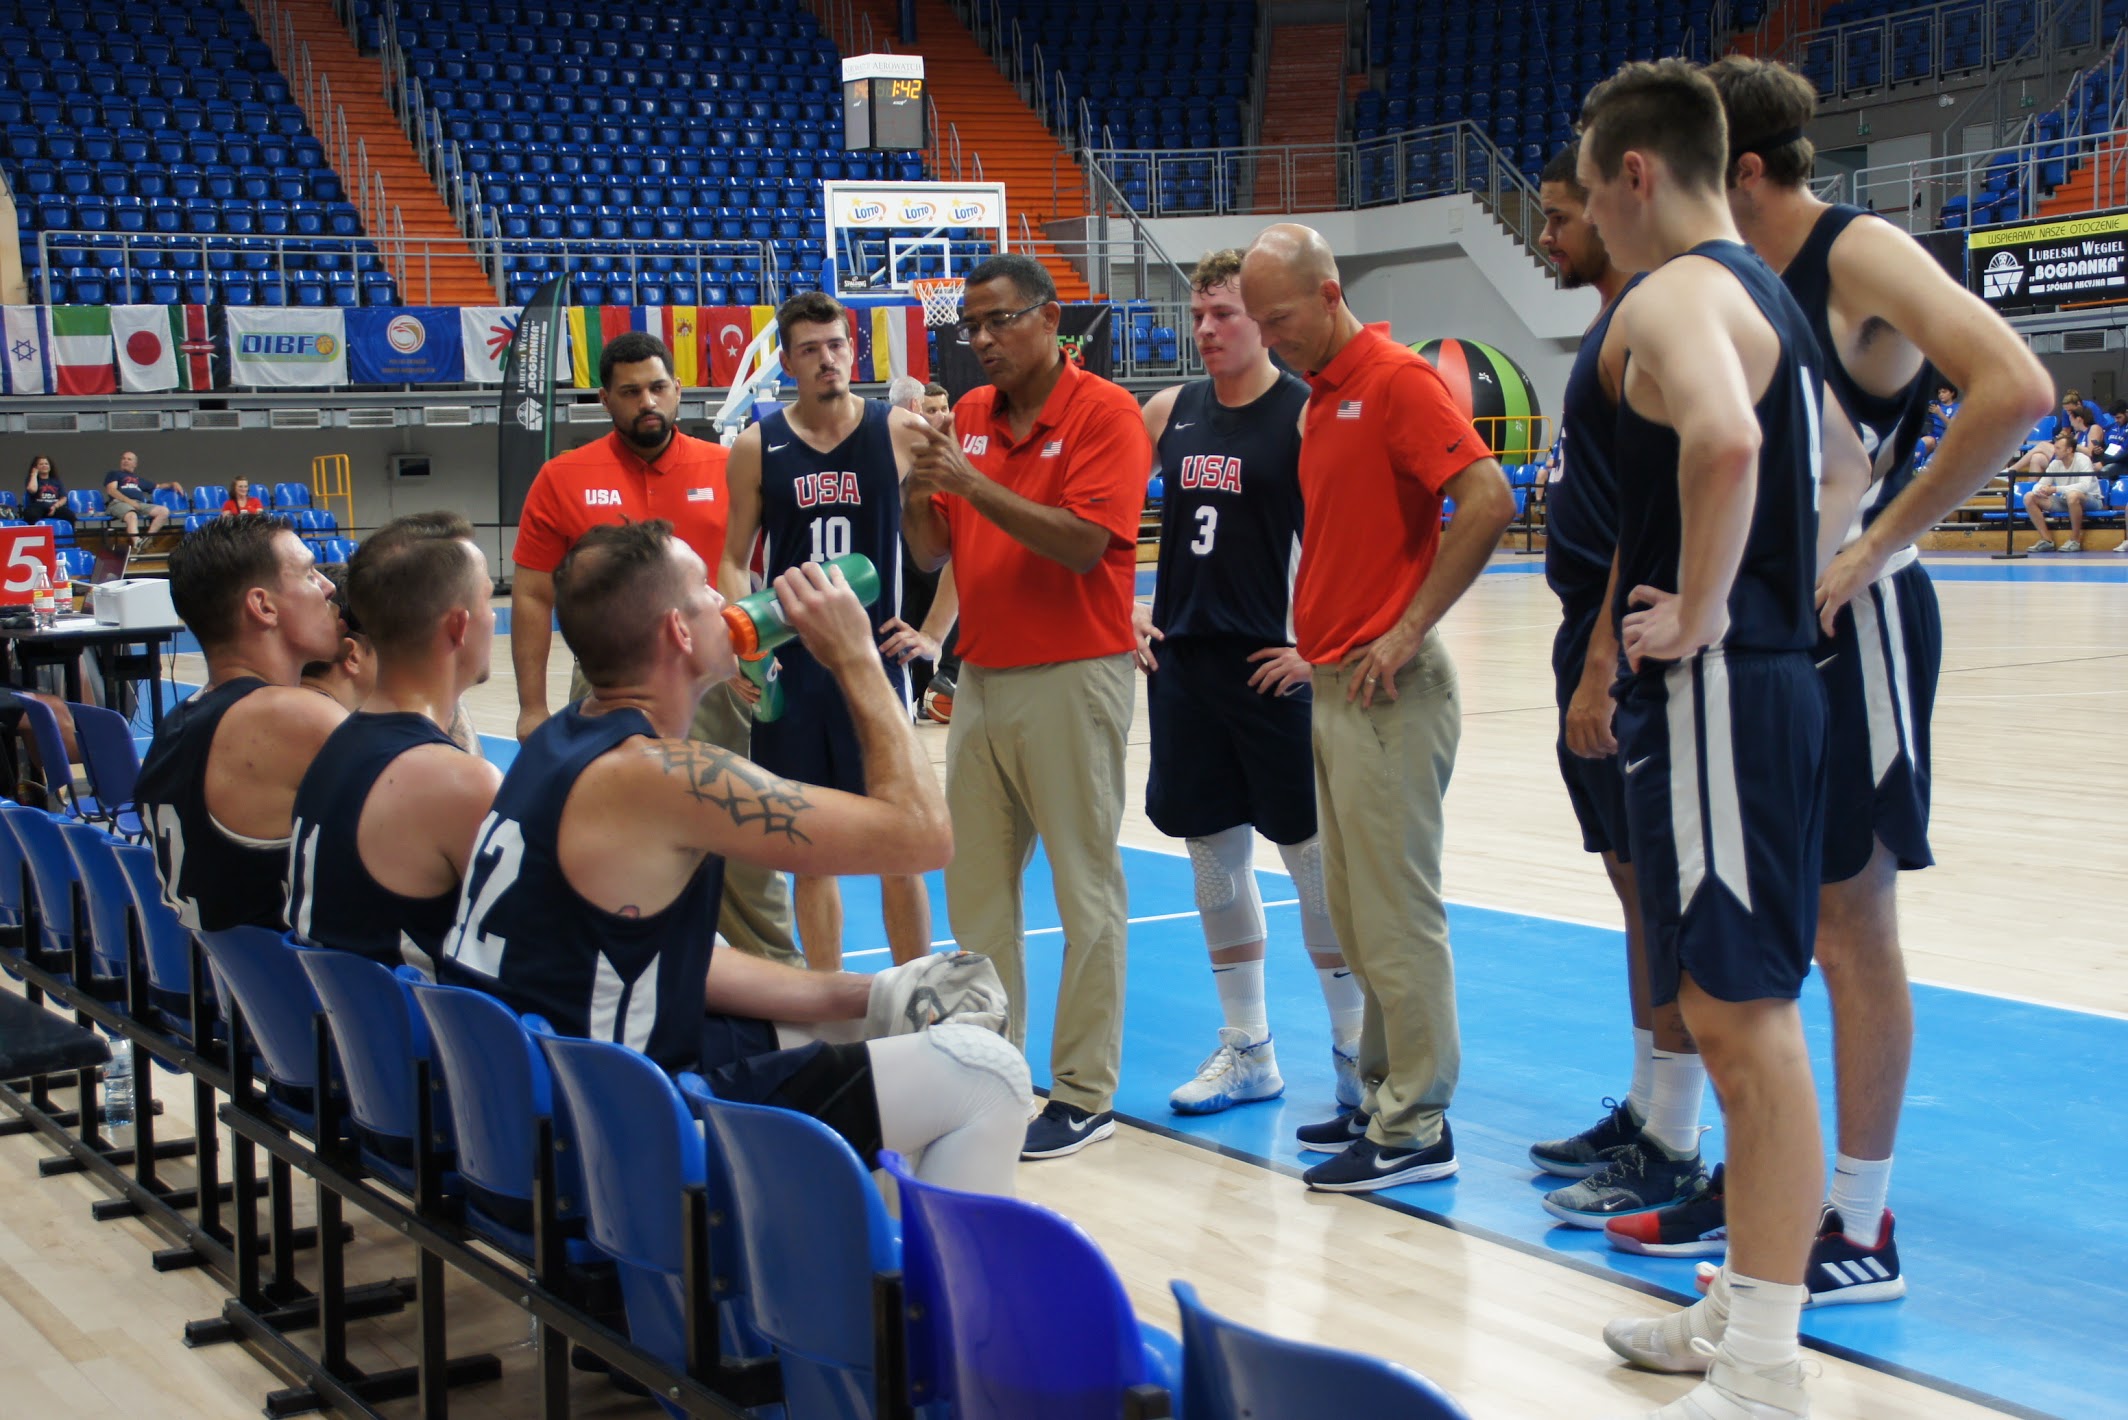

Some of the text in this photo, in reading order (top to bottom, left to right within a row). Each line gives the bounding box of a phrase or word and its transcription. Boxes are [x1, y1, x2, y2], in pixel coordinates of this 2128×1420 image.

[872, 62, 922, 72] AEROWATCH
[891, 80, 922, 99] 1:42
[854, 205, 880, 219] LOTTO
[904, 205, 930, 219] LOTTO
[954, 205, 979, 219] LOTTO
[1987, 219, 2120, 245] WSPIERAMY NASZE OTOCZENIE
[2028, 240, 2125, 262] LUBELSKI WĘGIEL
[2074, 278, 2106, 289] AKCYJNA
[242, 334, 314, 355] DIBF
[1180, 455, 1242, 493] USA
[585, 489, 622, 505] USA
[794, 471, 861, 508] USA
[810, 516, 851, 563] 10
[1191, 505, 1218, 555] 3
[3, 535, 45, 592] 5
